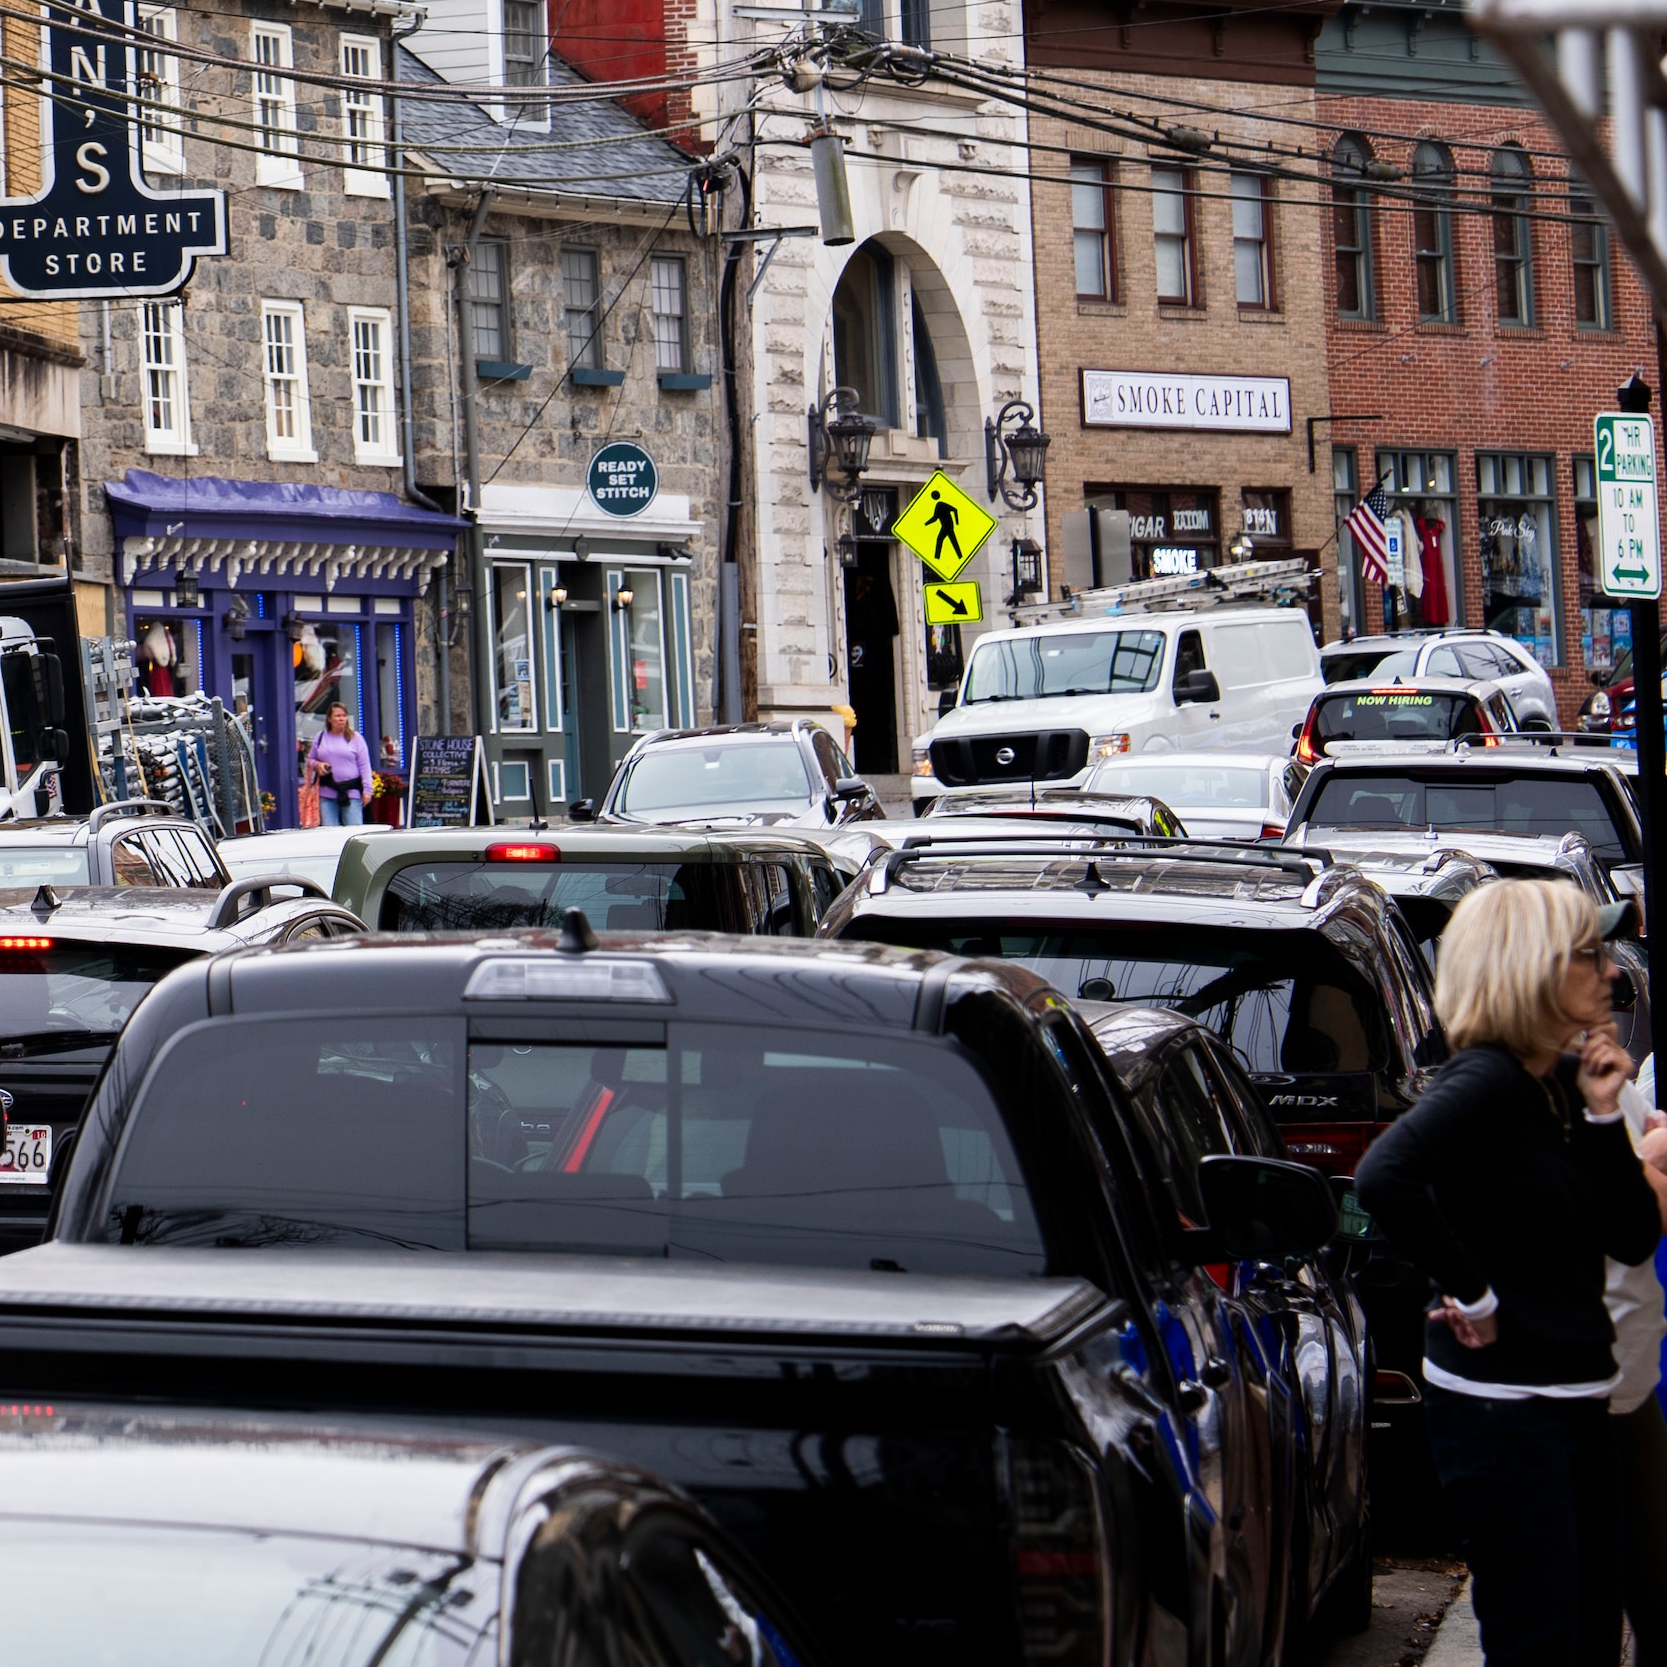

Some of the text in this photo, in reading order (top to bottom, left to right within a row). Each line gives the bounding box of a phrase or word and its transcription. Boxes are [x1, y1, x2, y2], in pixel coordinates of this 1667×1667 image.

[45, 251, 147, 276] STORE
[1118, 385, 1186, 414] SMOKE
[1195, 388, 1281, 419] CAPITAL
[1599, 426, 1641, 471] 2 HR
[598, 461, 646, 473] READY
[1616, 454, 1652, 477] PARKING
[608, 474, 636, 486] SET
[596, 487, 650, 499] STITCH
[1613, 488, 1643, 509] 10 AM
[1129, 515, 1165, 538] IGAR
[1490, 520, 1535, 543] Pink Sky
[1622, 514, 1635, 533] TO
[1618, 539, 1643, 560] 6 PM
[1153, 547, 1198, 574] SMOKE
[1356, 696, 1433, 706] NOW HIRING
[419, 738, 474, 751] STONE HOUSE
[422, 751, 467, 759] COLLECTIVE
[1269, 1095, 1339, 1106] MDX
